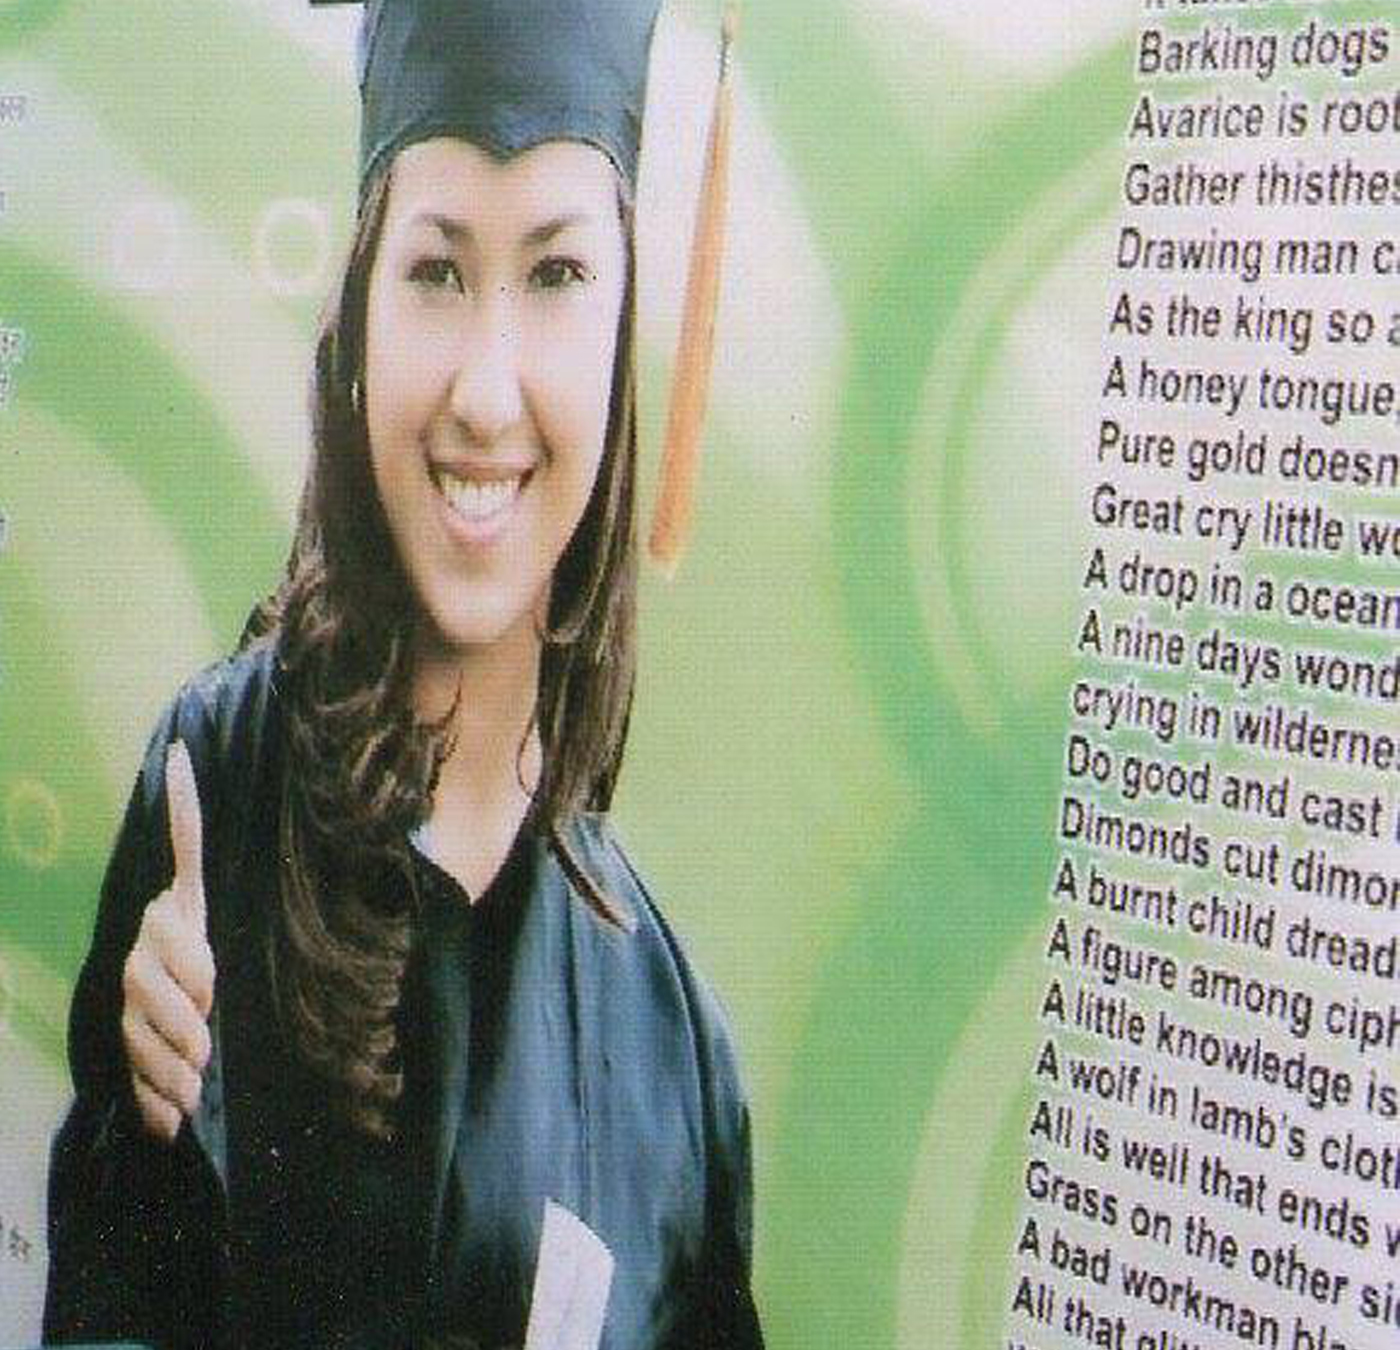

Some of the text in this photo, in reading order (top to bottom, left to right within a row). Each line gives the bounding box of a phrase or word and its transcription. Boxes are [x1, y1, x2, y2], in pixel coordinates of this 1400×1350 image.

[1140, 23, 1390, 79] Barking dogs
[1131, 97, 1264, 139] Avarice
[1279, 91, 1307, 134] is
[1126, 163, 1245, 206] Gather
[1118, 227, 1358, 282] Drawing man
[1111, 294, 1374, 355] As the king so
[1104, 355, 1248, 417] A honey
[1097, 420, 1175, 468] Pure
[1188, 430, 1265, 481] gold
[1093, 486, 1184, 536] Great
[1197, 504, 1253, 550] cry
[1264, 500, 1344, 551] little
[1084, 548, 1400, 630] A drop in a ocean
[1078, 609, 1102, 653] A
[1114, 617, 1185, 665] nine
[1196, 629, 1282, 689] days
[1073, 680, 1400, 773] crying in wilderne
[1066, 735, 1383, 839] Do good and cast
[1061, 797, 1280, 886] Dimonds cut
[1054, 858, 1078, 900] A
[1088, 865, 1178, 927] burnt
[1188, 895, 1276, 950] child
[1048, 917, 1313, 1039] A figure among
[1042, 979, 1400, 1118] A little knowledge is
[1036, 1040, 1308, 1161] A wolf in lamb's
[1030, 1100, 1370, 1248] All is well that ends
[1025, 1160, 1348, 1306] Grass on the other
[1012, 1276, 1055, 1326] All
[1018, 1218, 1041, 1259] A
[1050, 1229, 1111, 1286] bad
[1122, 1262, 1279, 1350] workman
